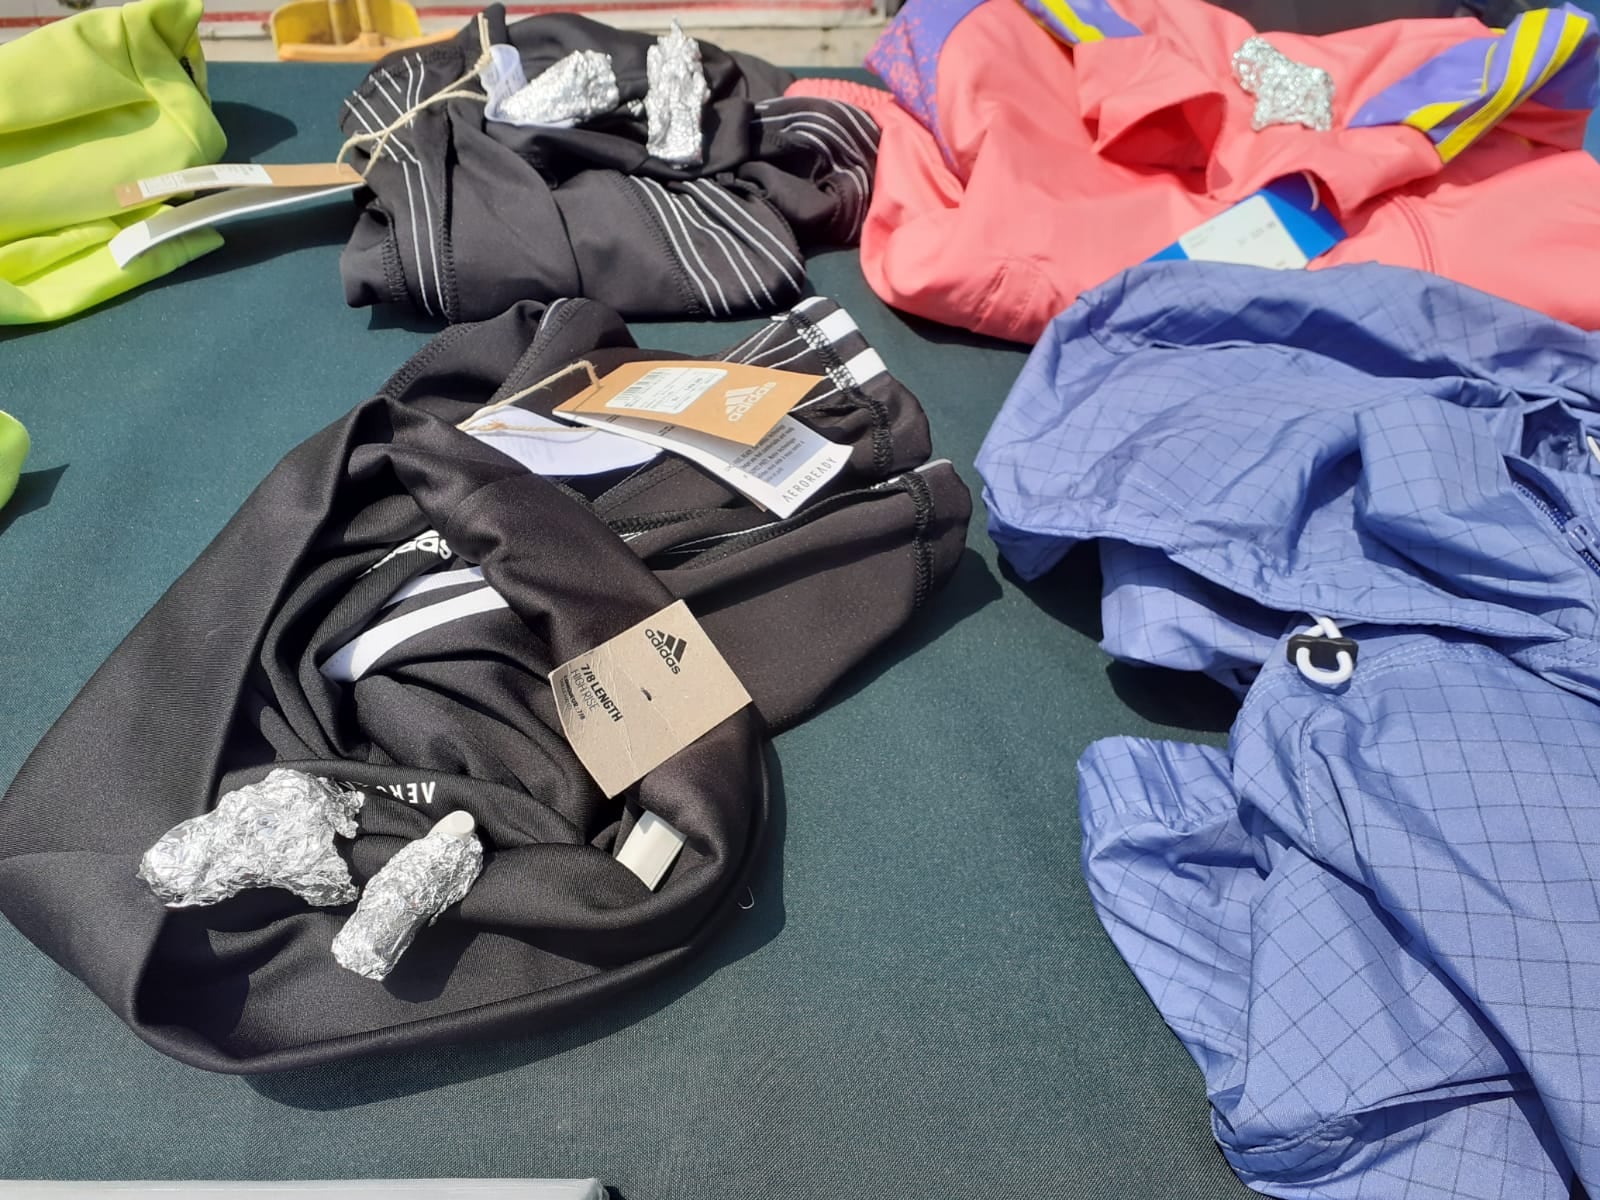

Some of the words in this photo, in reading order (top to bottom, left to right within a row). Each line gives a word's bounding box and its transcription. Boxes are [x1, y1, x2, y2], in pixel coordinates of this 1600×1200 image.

[727, 381, 777, 422] adidas
[781, 456, 837, 503] AEROREADY
[644, 628, 681, 675] adidas
[570, 668, 586, 694] HIGH
[582, 689, 599, 712] RISE
[580, 663, 596, 683] 7/8
[590, 679, 623, 722] LENGTH
